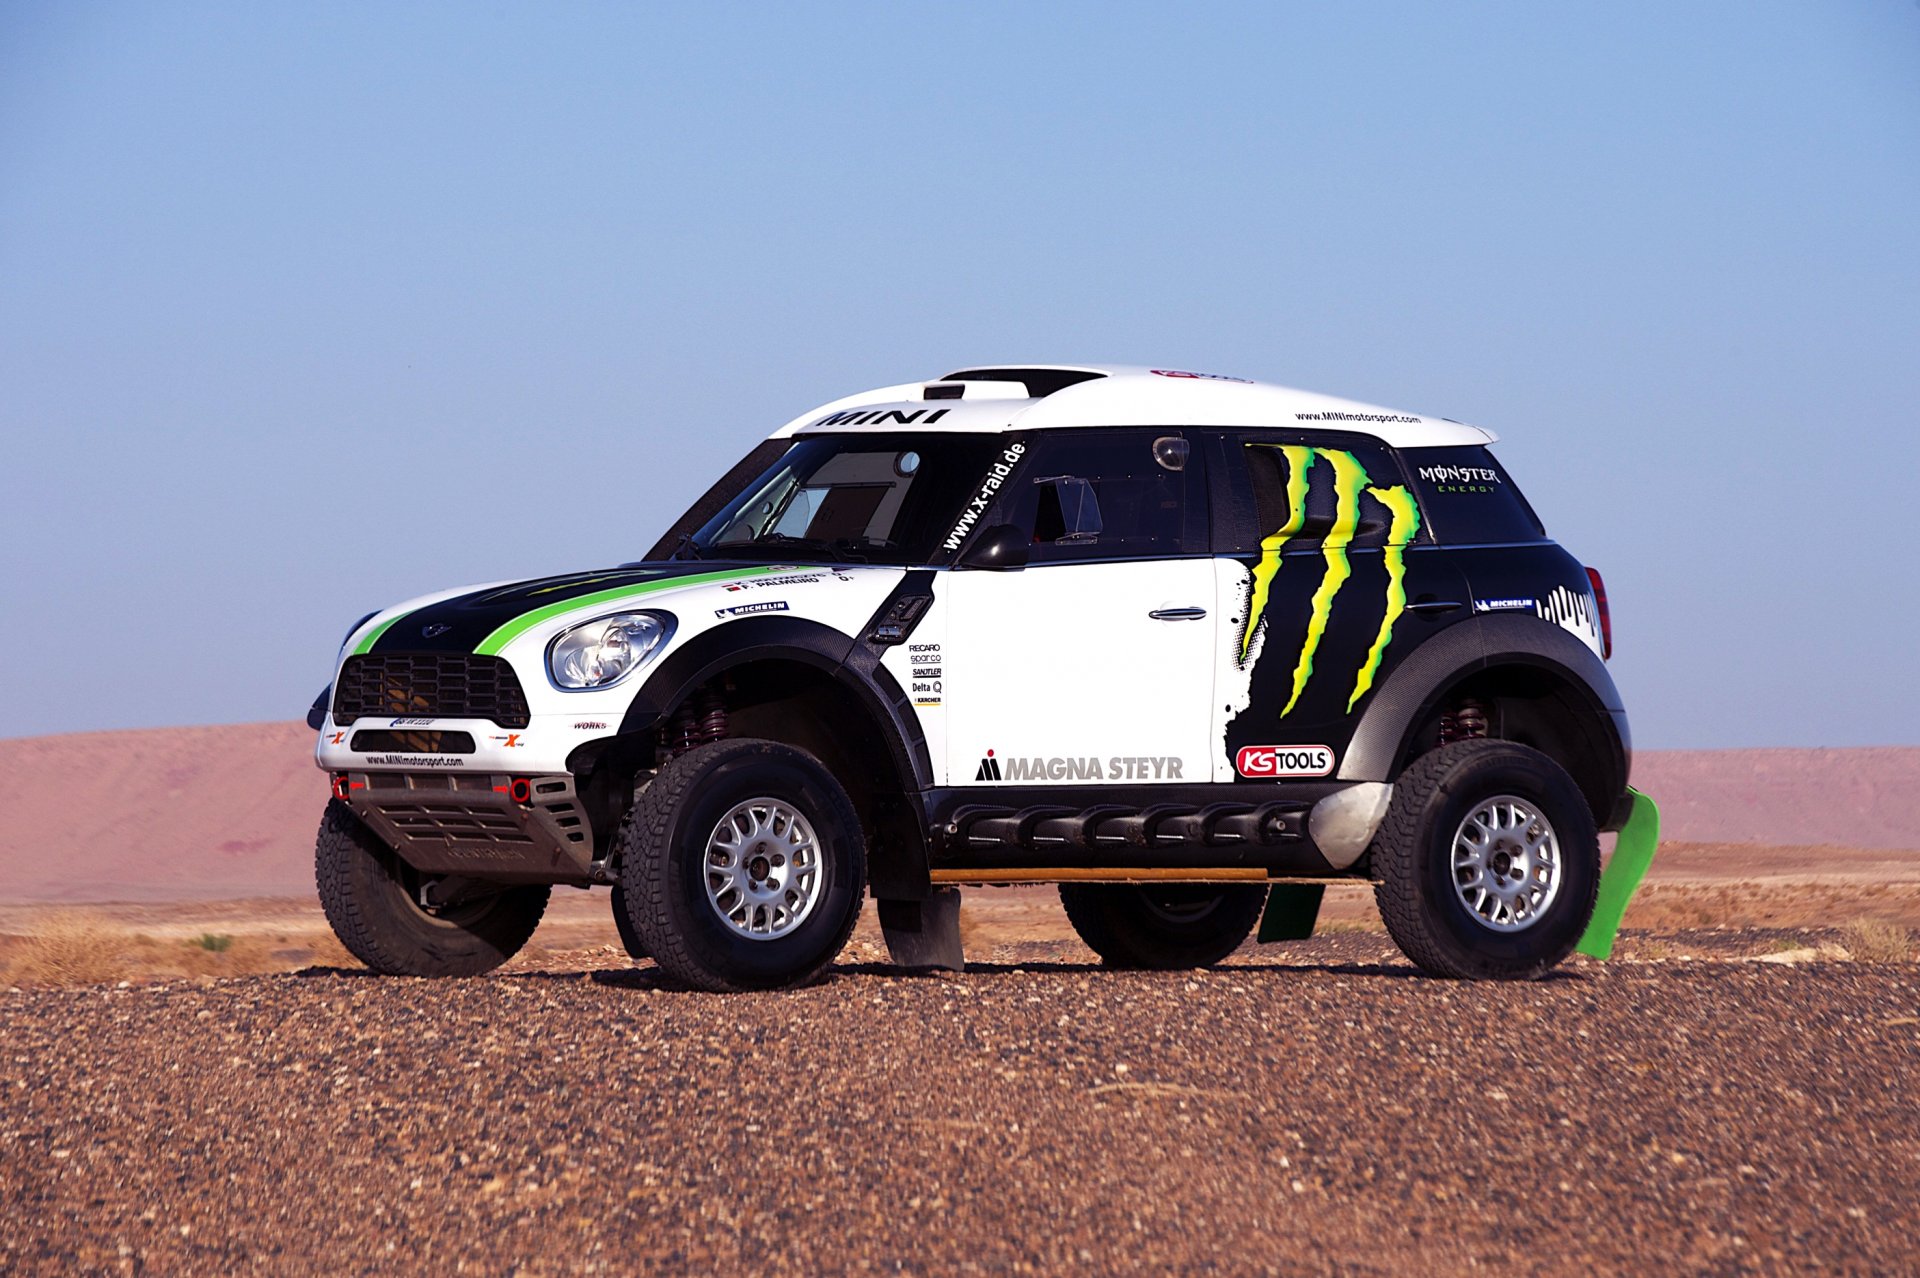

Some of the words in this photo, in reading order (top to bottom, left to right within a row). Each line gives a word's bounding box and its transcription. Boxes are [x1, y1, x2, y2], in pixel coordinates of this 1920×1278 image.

[816, 409, 951, 426] MINI
[1295, 412, 1421, 423] www.MINImotorsport.com
[1419, 465, 1501, 483] MONSTER
[943, 443, 1026, 551] www.x-raid.de
[756, 577, 820, 588] PALMEIRO
[734, 602, 786, 614] MICHELIN
[1490, 599, 1533, 608] MICHELIN
[909, 644, 941, 652] RECARO
[910, 654, 942, 664] sparco
[912, 683, 931, 692] Delta
[933, 681, 942, 693] Q
[574, 722, 607, 730] WORKS
[366, 755, 464, 768] www.MINImotorsport.com
[1243, 751, 1276, 772] KS
[1274, 752, 1327, 770] TOOLS
[1004, 757, 1104, 781] MAGNA
[1108, 757, 1184, 780] STEYR
